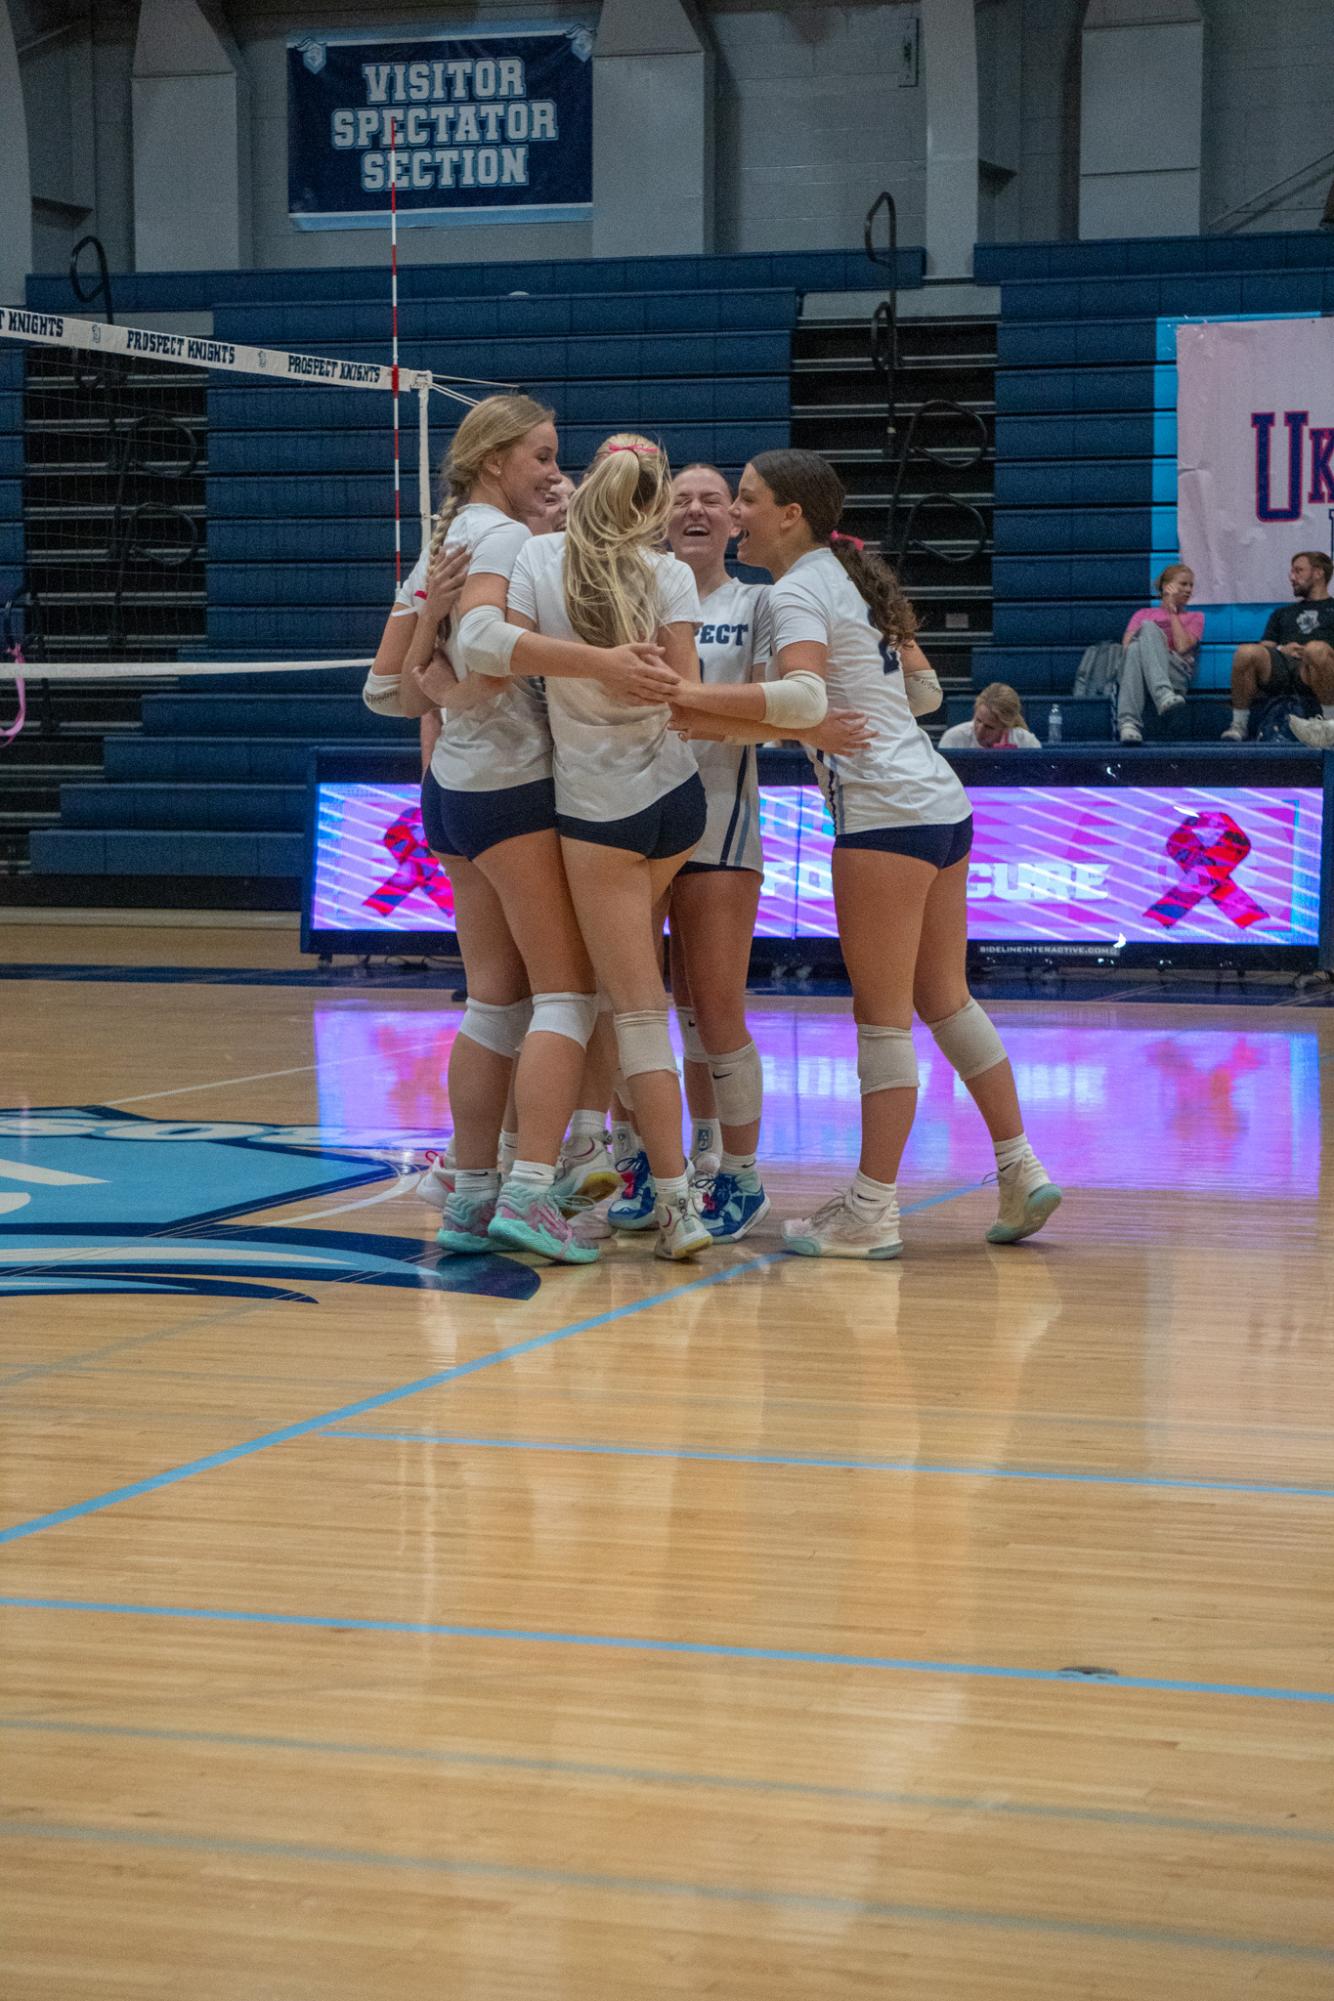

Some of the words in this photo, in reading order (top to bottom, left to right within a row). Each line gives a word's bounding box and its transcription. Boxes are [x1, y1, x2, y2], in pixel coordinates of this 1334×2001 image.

[362, 56, 526, 105] VISITOR
[331, 99, 559, 149] SPECTATOR
[360, 145, 529, 192] SECTION
[8, 310, 64, 337] KNIGHTS
[126, 329, 185, 357] PROSPECT
[187, 340, 235, 364] KNIGHTS
[287, 354, 338, 379] PROSPECT
